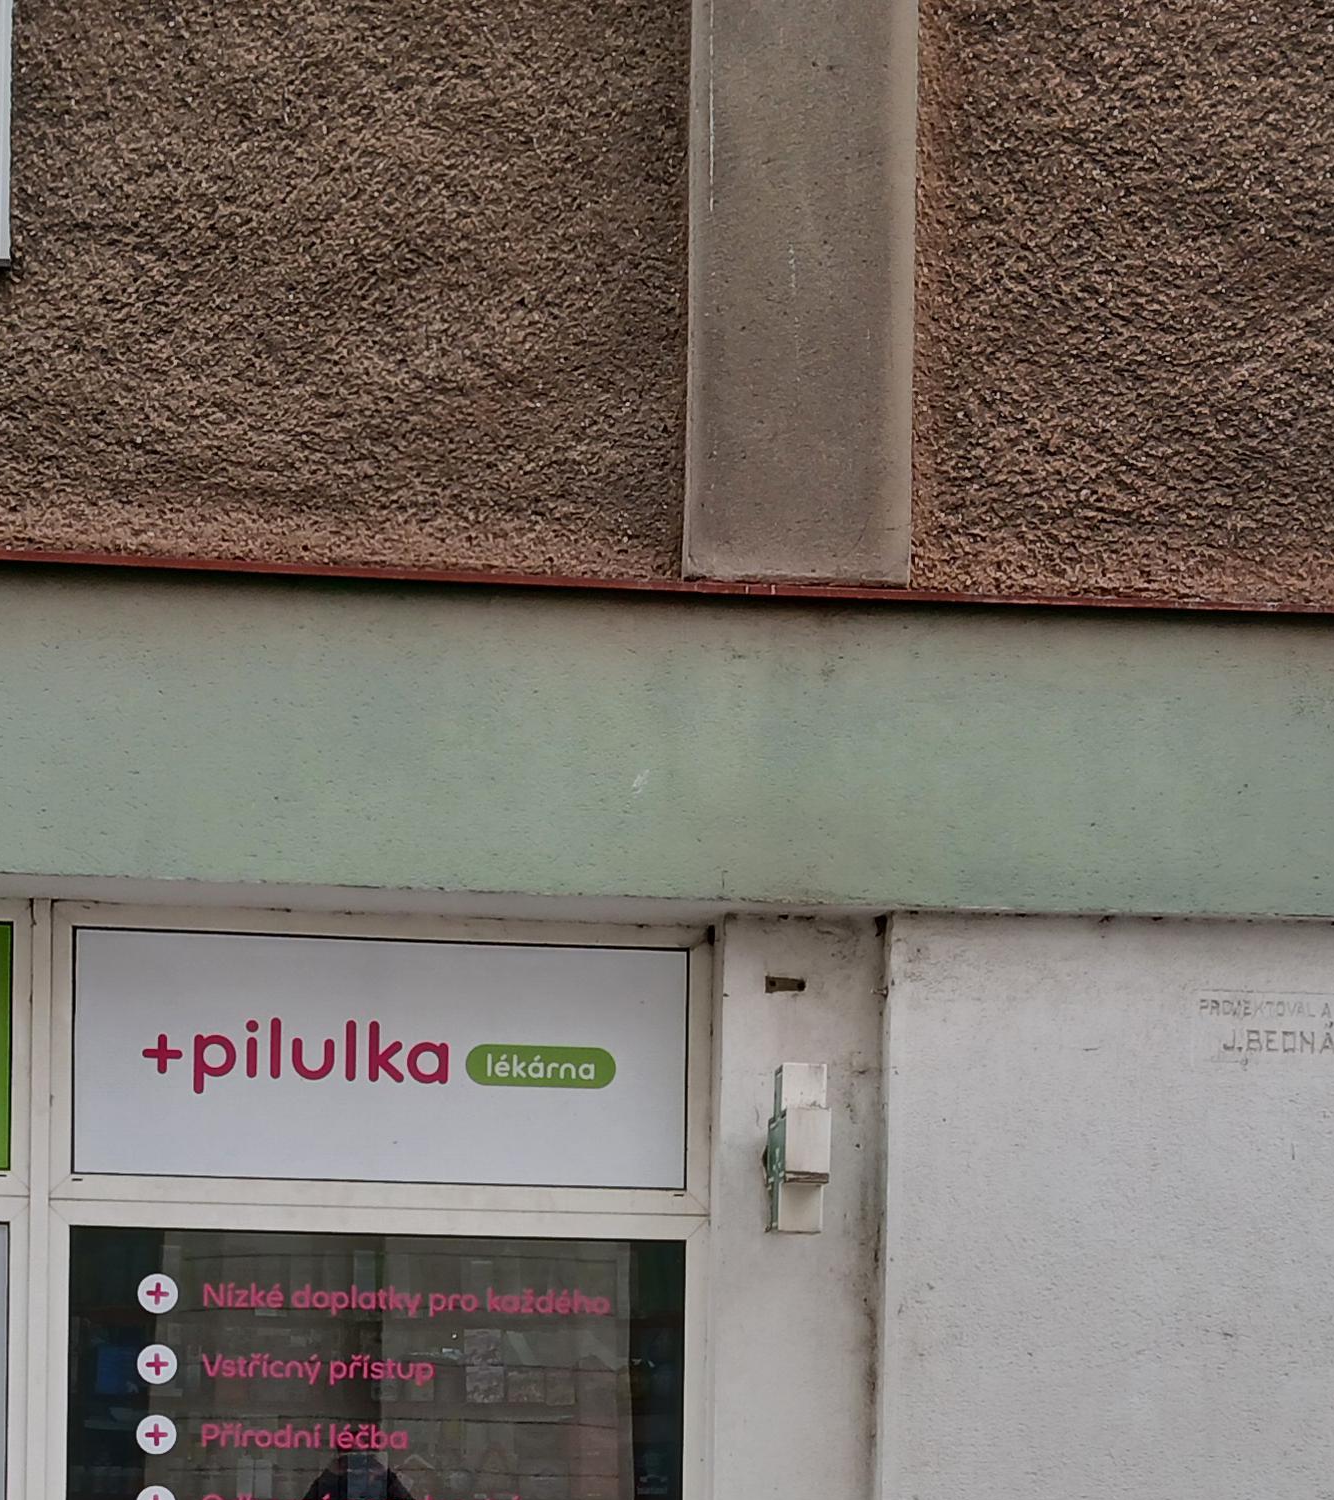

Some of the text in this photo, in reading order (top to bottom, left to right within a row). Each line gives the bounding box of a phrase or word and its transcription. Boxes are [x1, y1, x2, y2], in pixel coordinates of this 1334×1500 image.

[485, 1053, 596, 1081] lékárna
[201, 1283, 611, 1317] Nízké doplatky pro každého
[200, 1352, 436, 1387] Vstřícný přístup
[200, 1423, 409, 1451] Přírodní léčba
